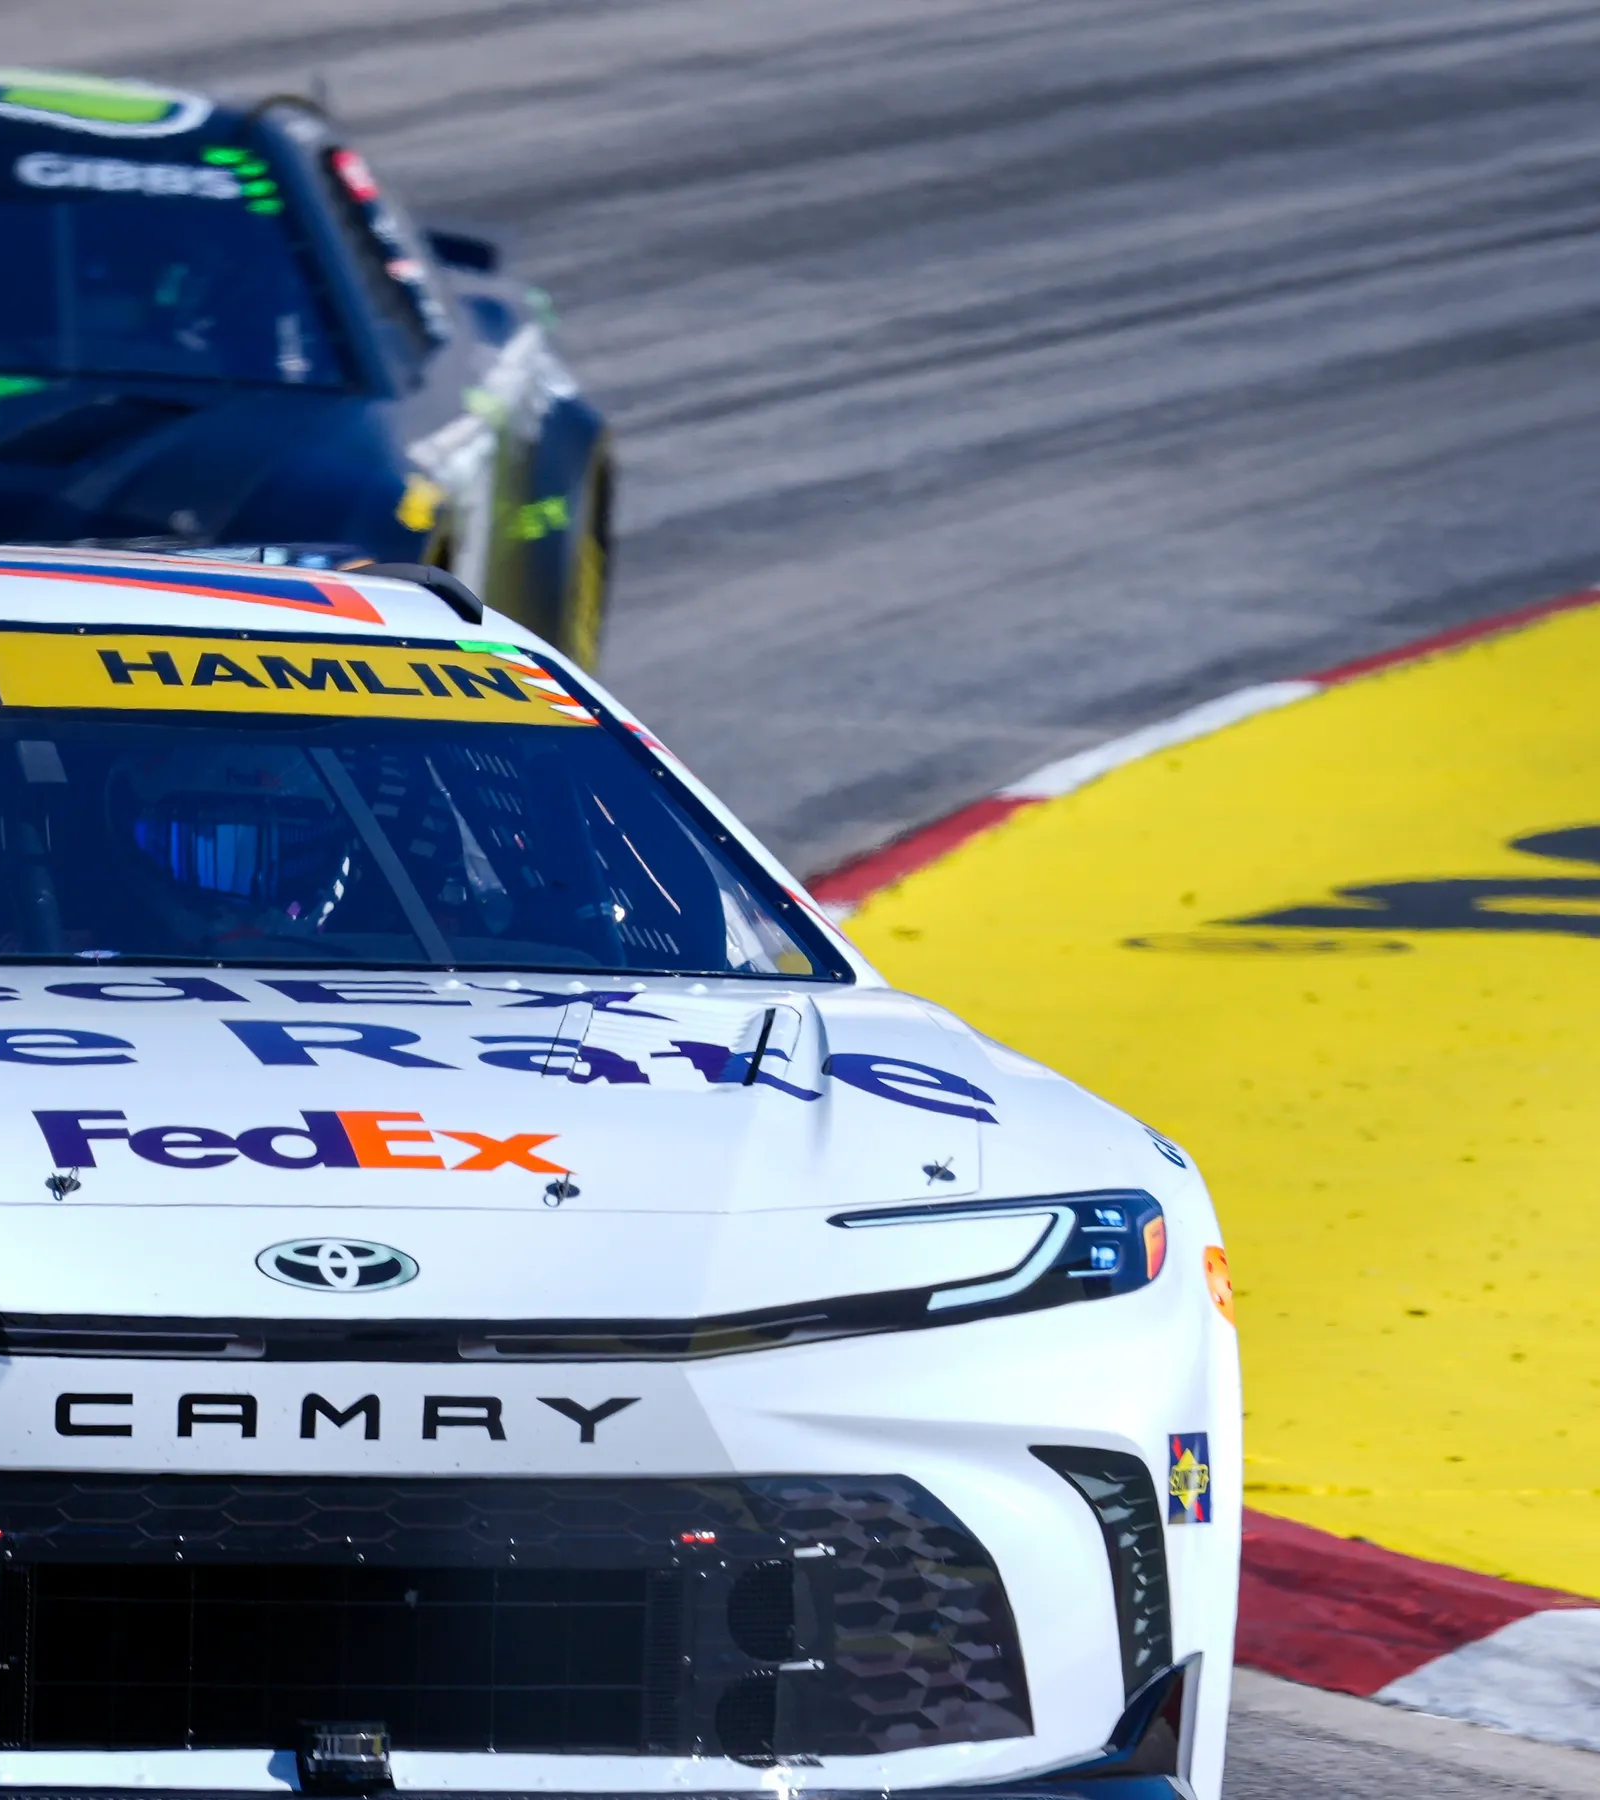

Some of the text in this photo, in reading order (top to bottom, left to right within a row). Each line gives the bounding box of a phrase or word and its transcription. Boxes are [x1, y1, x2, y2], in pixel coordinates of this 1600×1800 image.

[13, 151, 242, 200] GIBBS
[96, 649, 532, 702] HAMLIN
[221, 1018, 1001, 1125] Rate
[33, 1109, 578, 1175] FedEx
[54, 1392, 642, 1444] CAMRY
